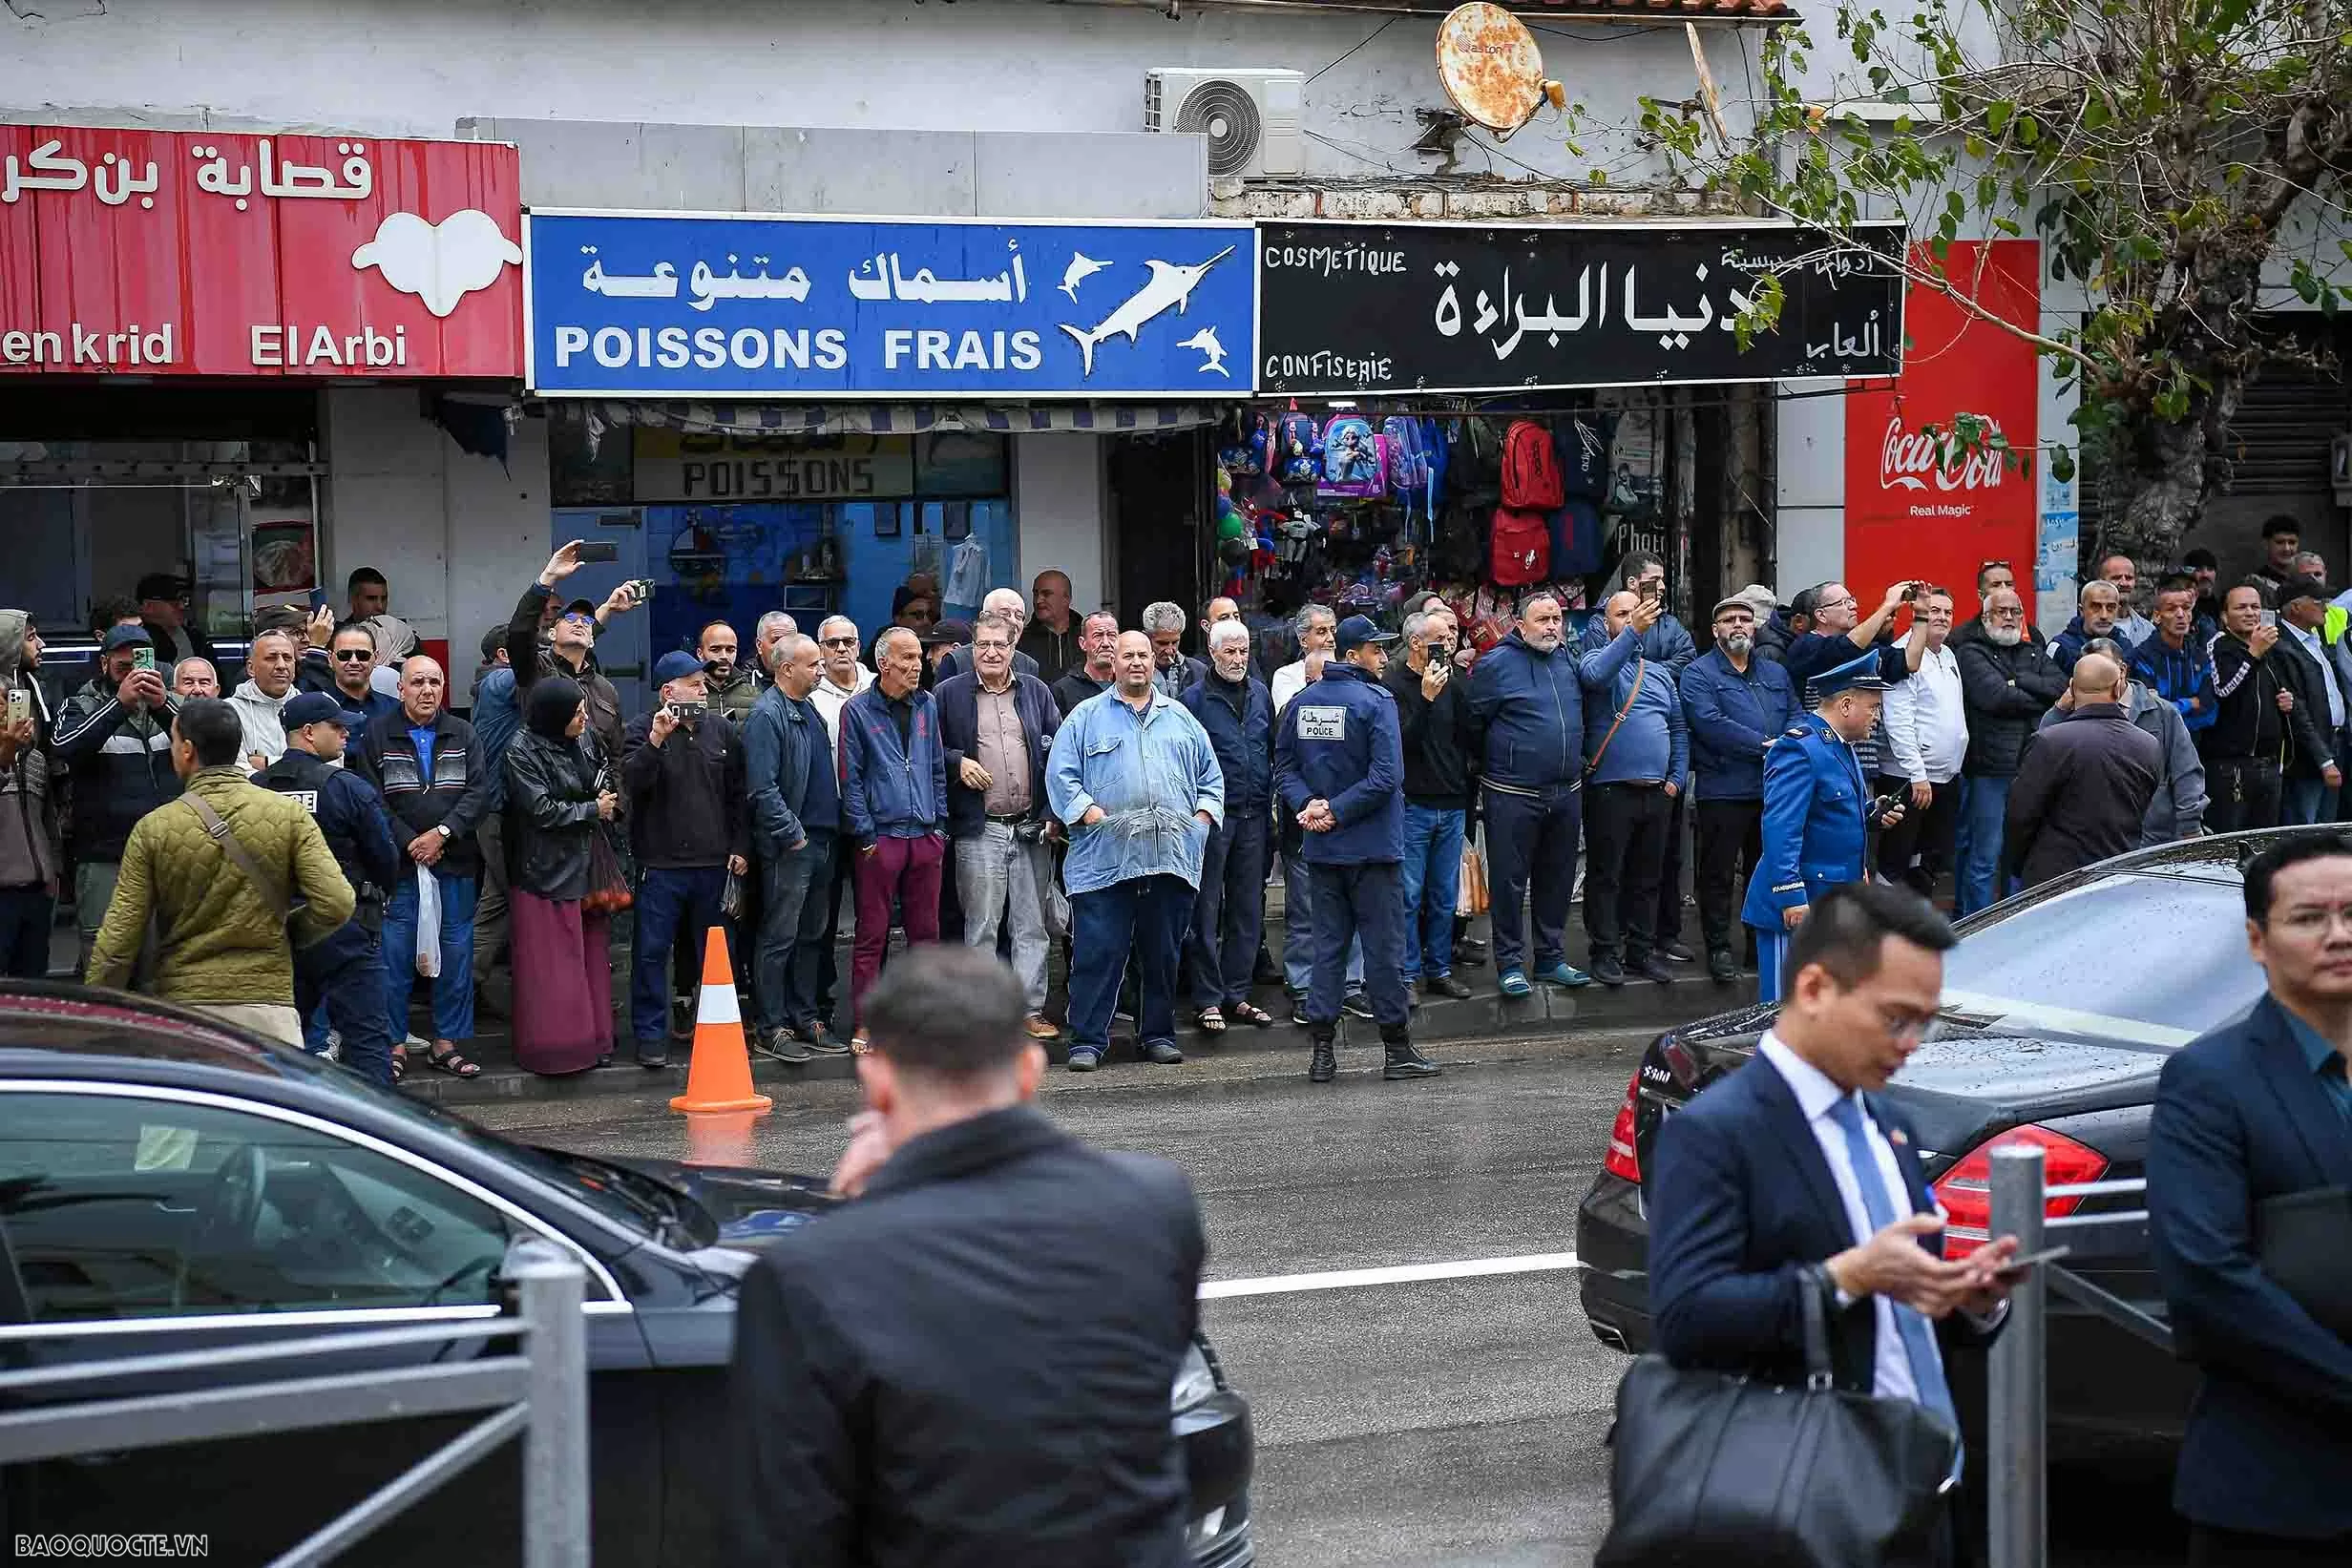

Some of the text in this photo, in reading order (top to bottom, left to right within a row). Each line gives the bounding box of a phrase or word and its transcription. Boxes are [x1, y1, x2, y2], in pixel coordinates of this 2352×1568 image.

[193, 138, 372, 211] قصابة
[580, 239, 1029, 311] أسماك متنوعة
[1434, 260, 1607, 361] البراءة
[556, 326, 1041, 370] POISSONS FRAIS
[681, 458, 874, 498] POISSONS
[1909, 504, 1971, 518] Real Magic
[1301, 709, 1340, 726] شرطة
[1306, 727, 1334, 736] POLICE
